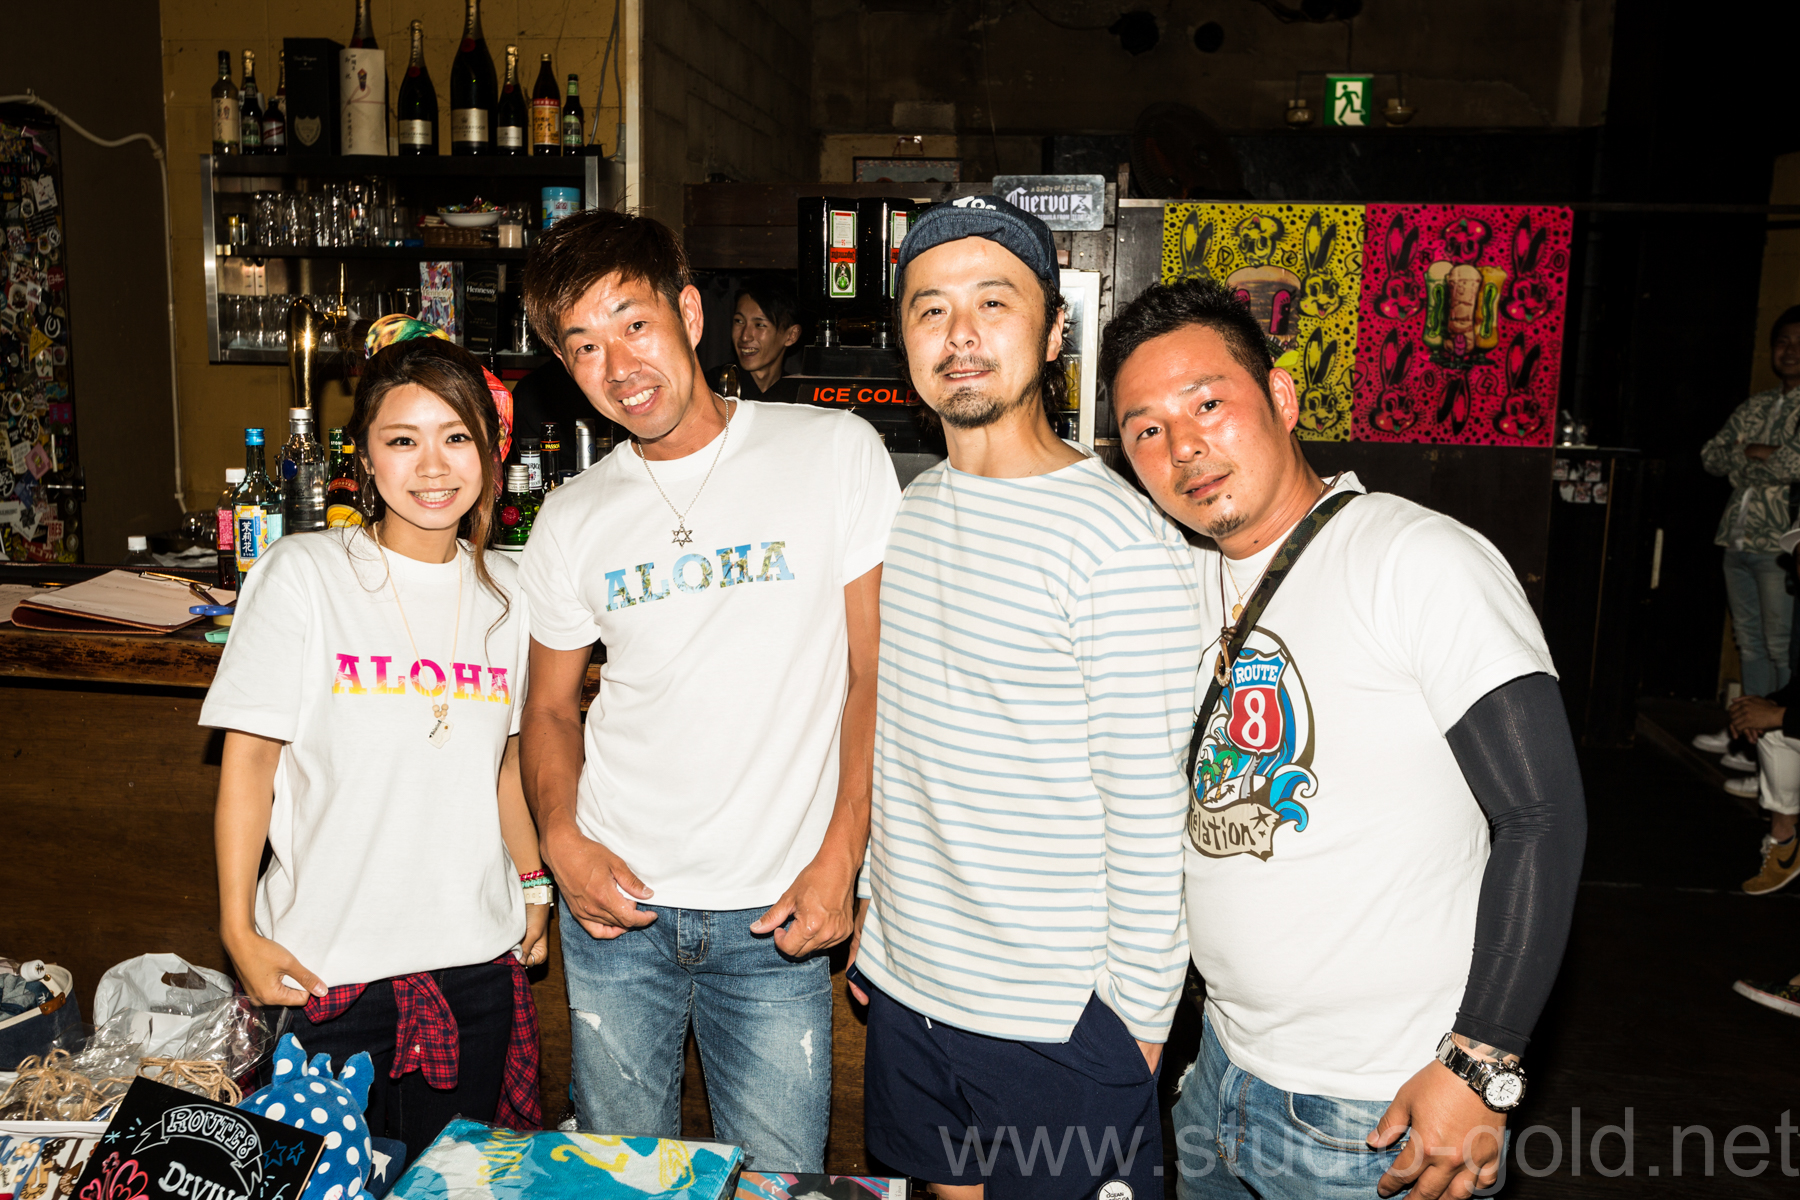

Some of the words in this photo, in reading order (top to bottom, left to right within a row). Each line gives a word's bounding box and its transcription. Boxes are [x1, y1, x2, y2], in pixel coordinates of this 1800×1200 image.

[1005, 187, 1069, 214] Cuervo
[1062, 184, 1075, 193] ICE
[466, 285, 497, 296] Hennessy
[813, 387, 851, 402] ICE
[857, 388, 920, 404] COLD
[241, 520, 254, 553] 茉莉花
[605, 541, 796, 612] ALOHA
[332, 652, 511, 706] ALOHA
[1235, 664, 1280, 684] ROUTE
[1241, 689, 1267, 748] 8
